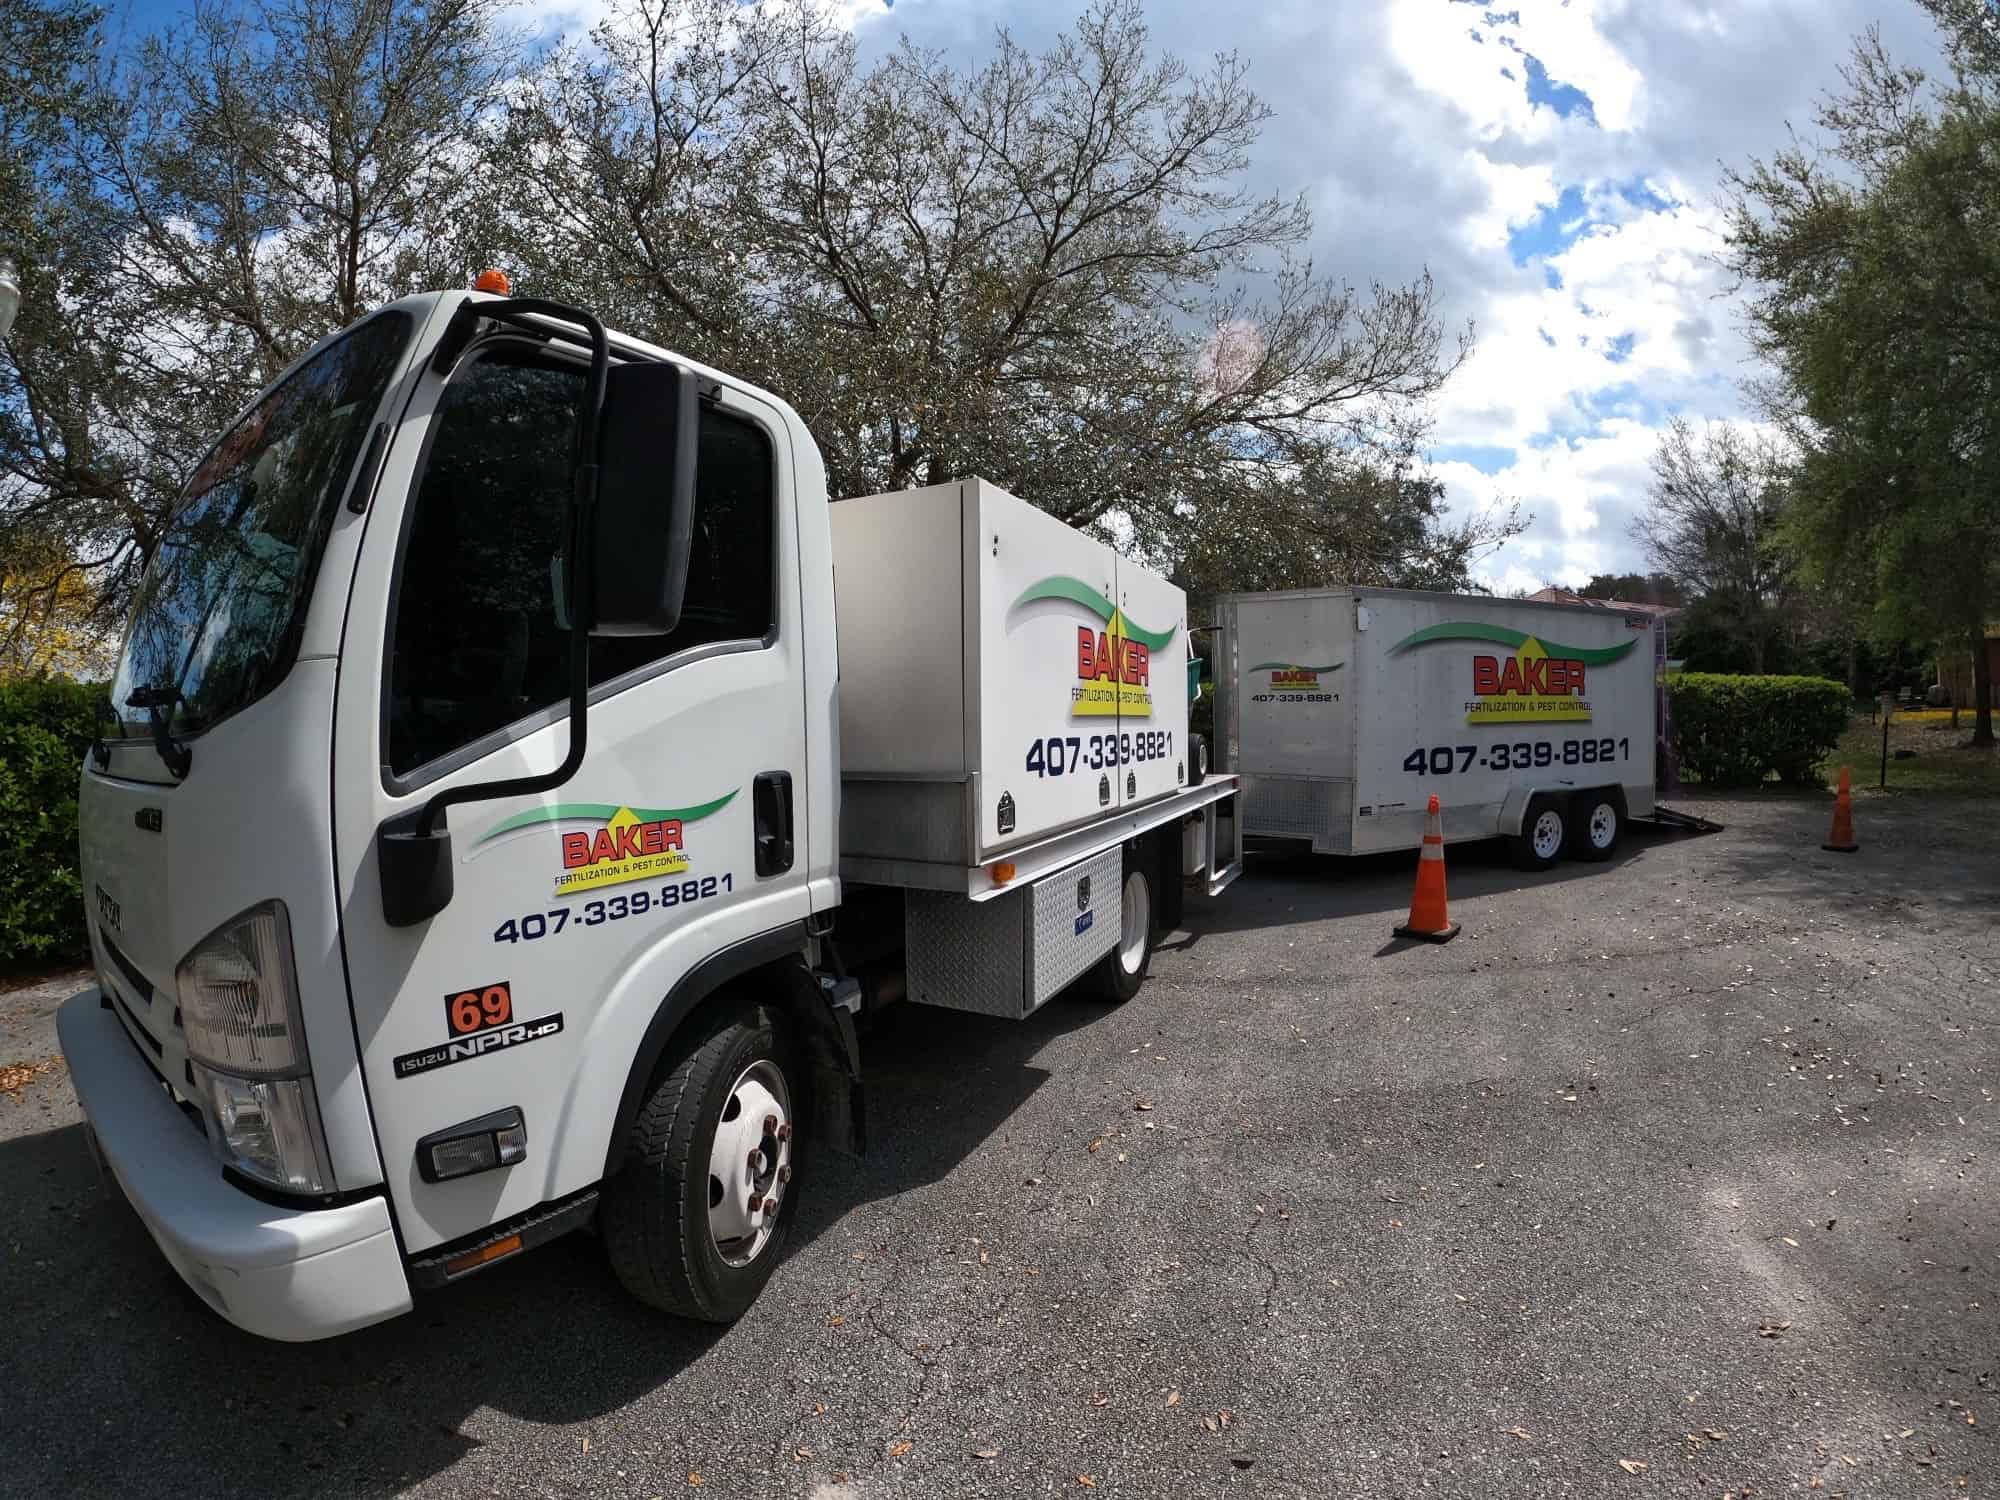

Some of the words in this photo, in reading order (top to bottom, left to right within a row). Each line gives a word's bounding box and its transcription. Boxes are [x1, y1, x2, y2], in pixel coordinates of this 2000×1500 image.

[1078, 626, 1149, 687] BAKER
[1474, 656, 1586, 696] BAKER
[1464, 701, 1526, 713] FERTILIZATION
[1537, 701, 1557, 712] PEST
[1559, 701, 1592, 712] CONTROL
[1026, 731, 1172, 778] 407-339-8821
[1403, 738, 1629, 776] 407-339-8821
[562, 819, 684, 869] BAKER
[554, 866, 621, 886] FERTILIZATION
[623, 864, 630, 873] &
[632, 860, 653, 872] PEST
[655, 853, 692, 867] CONTROL
[494, 873, 733, 943] 407-339-8821
[452, 986, 511, 1032] 69
[402, 1051, 447, 1072] ISUZU
